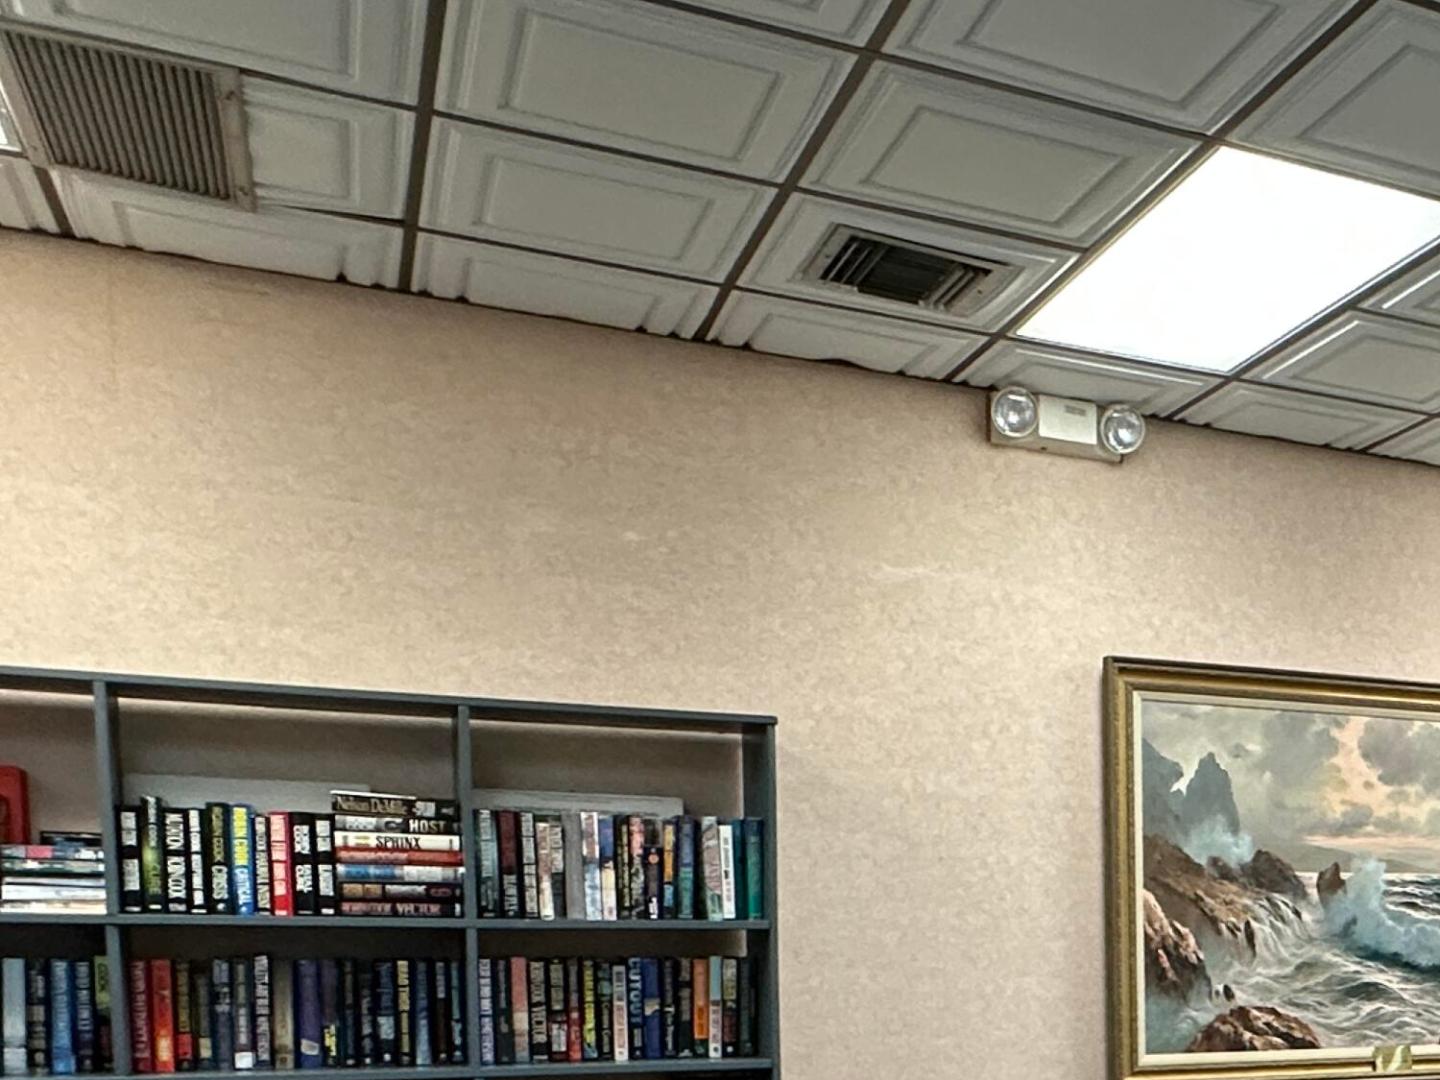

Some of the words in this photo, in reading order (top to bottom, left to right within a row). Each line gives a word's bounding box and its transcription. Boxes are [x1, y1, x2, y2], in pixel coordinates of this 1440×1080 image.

[376, 836, 421, 848] SPHINX
[409, 819, 446, 833] HOST
[212, 865, 228, 899] CRISIS
[236, 868, 251, 904] CRITICAL
[629, 957, 642, 1024] CUTOUT
[532, 1006, 547, 1043] VECTOR
